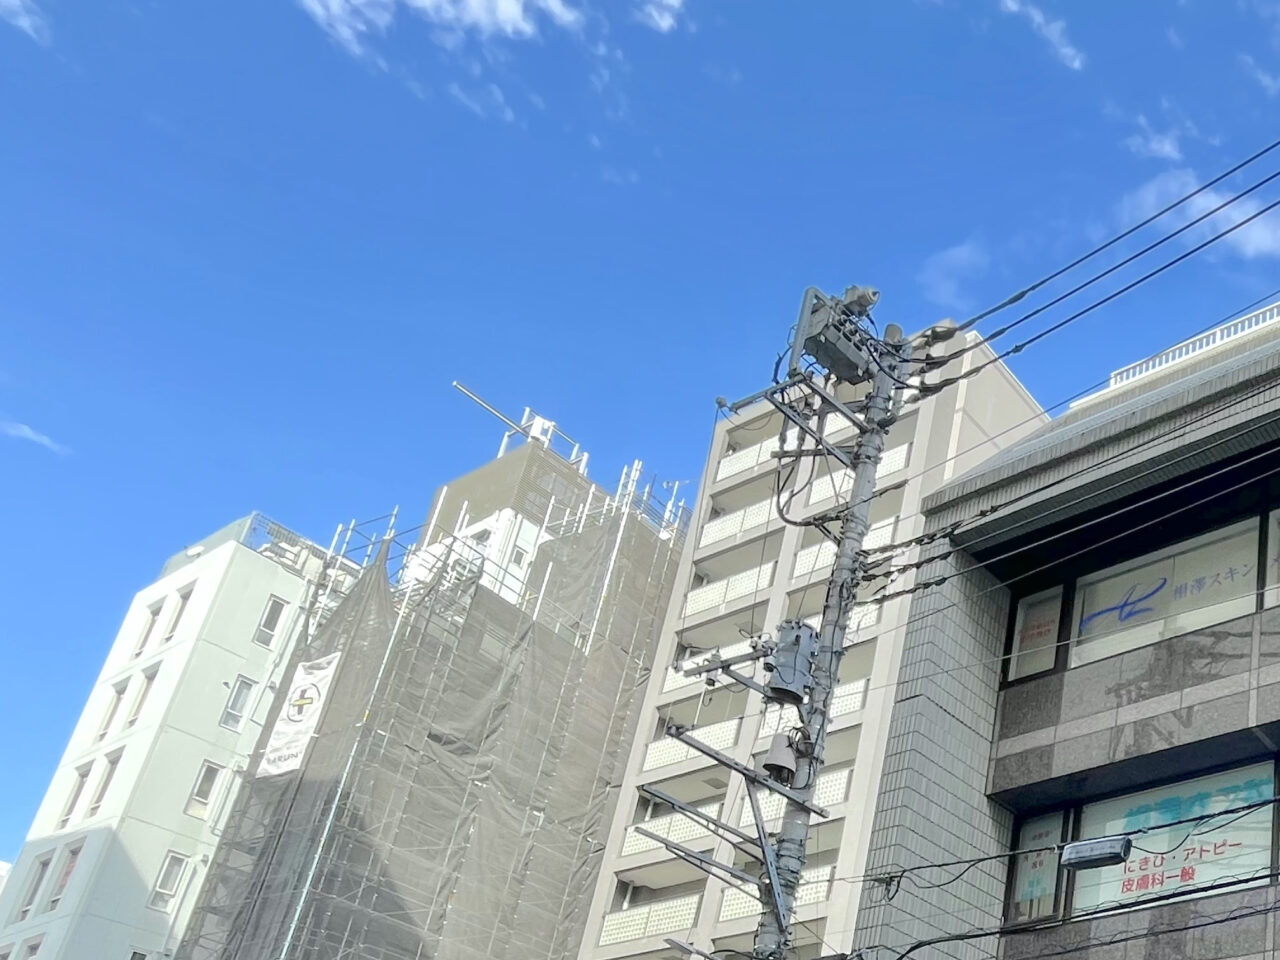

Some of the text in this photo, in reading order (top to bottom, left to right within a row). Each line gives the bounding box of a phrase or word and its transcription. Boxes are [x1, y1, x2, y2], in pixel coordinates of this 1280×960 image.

[1123, 839, 1242, 874] にきび・アトピー
[1121, 866, 1196, 894] 皮膚科一般
